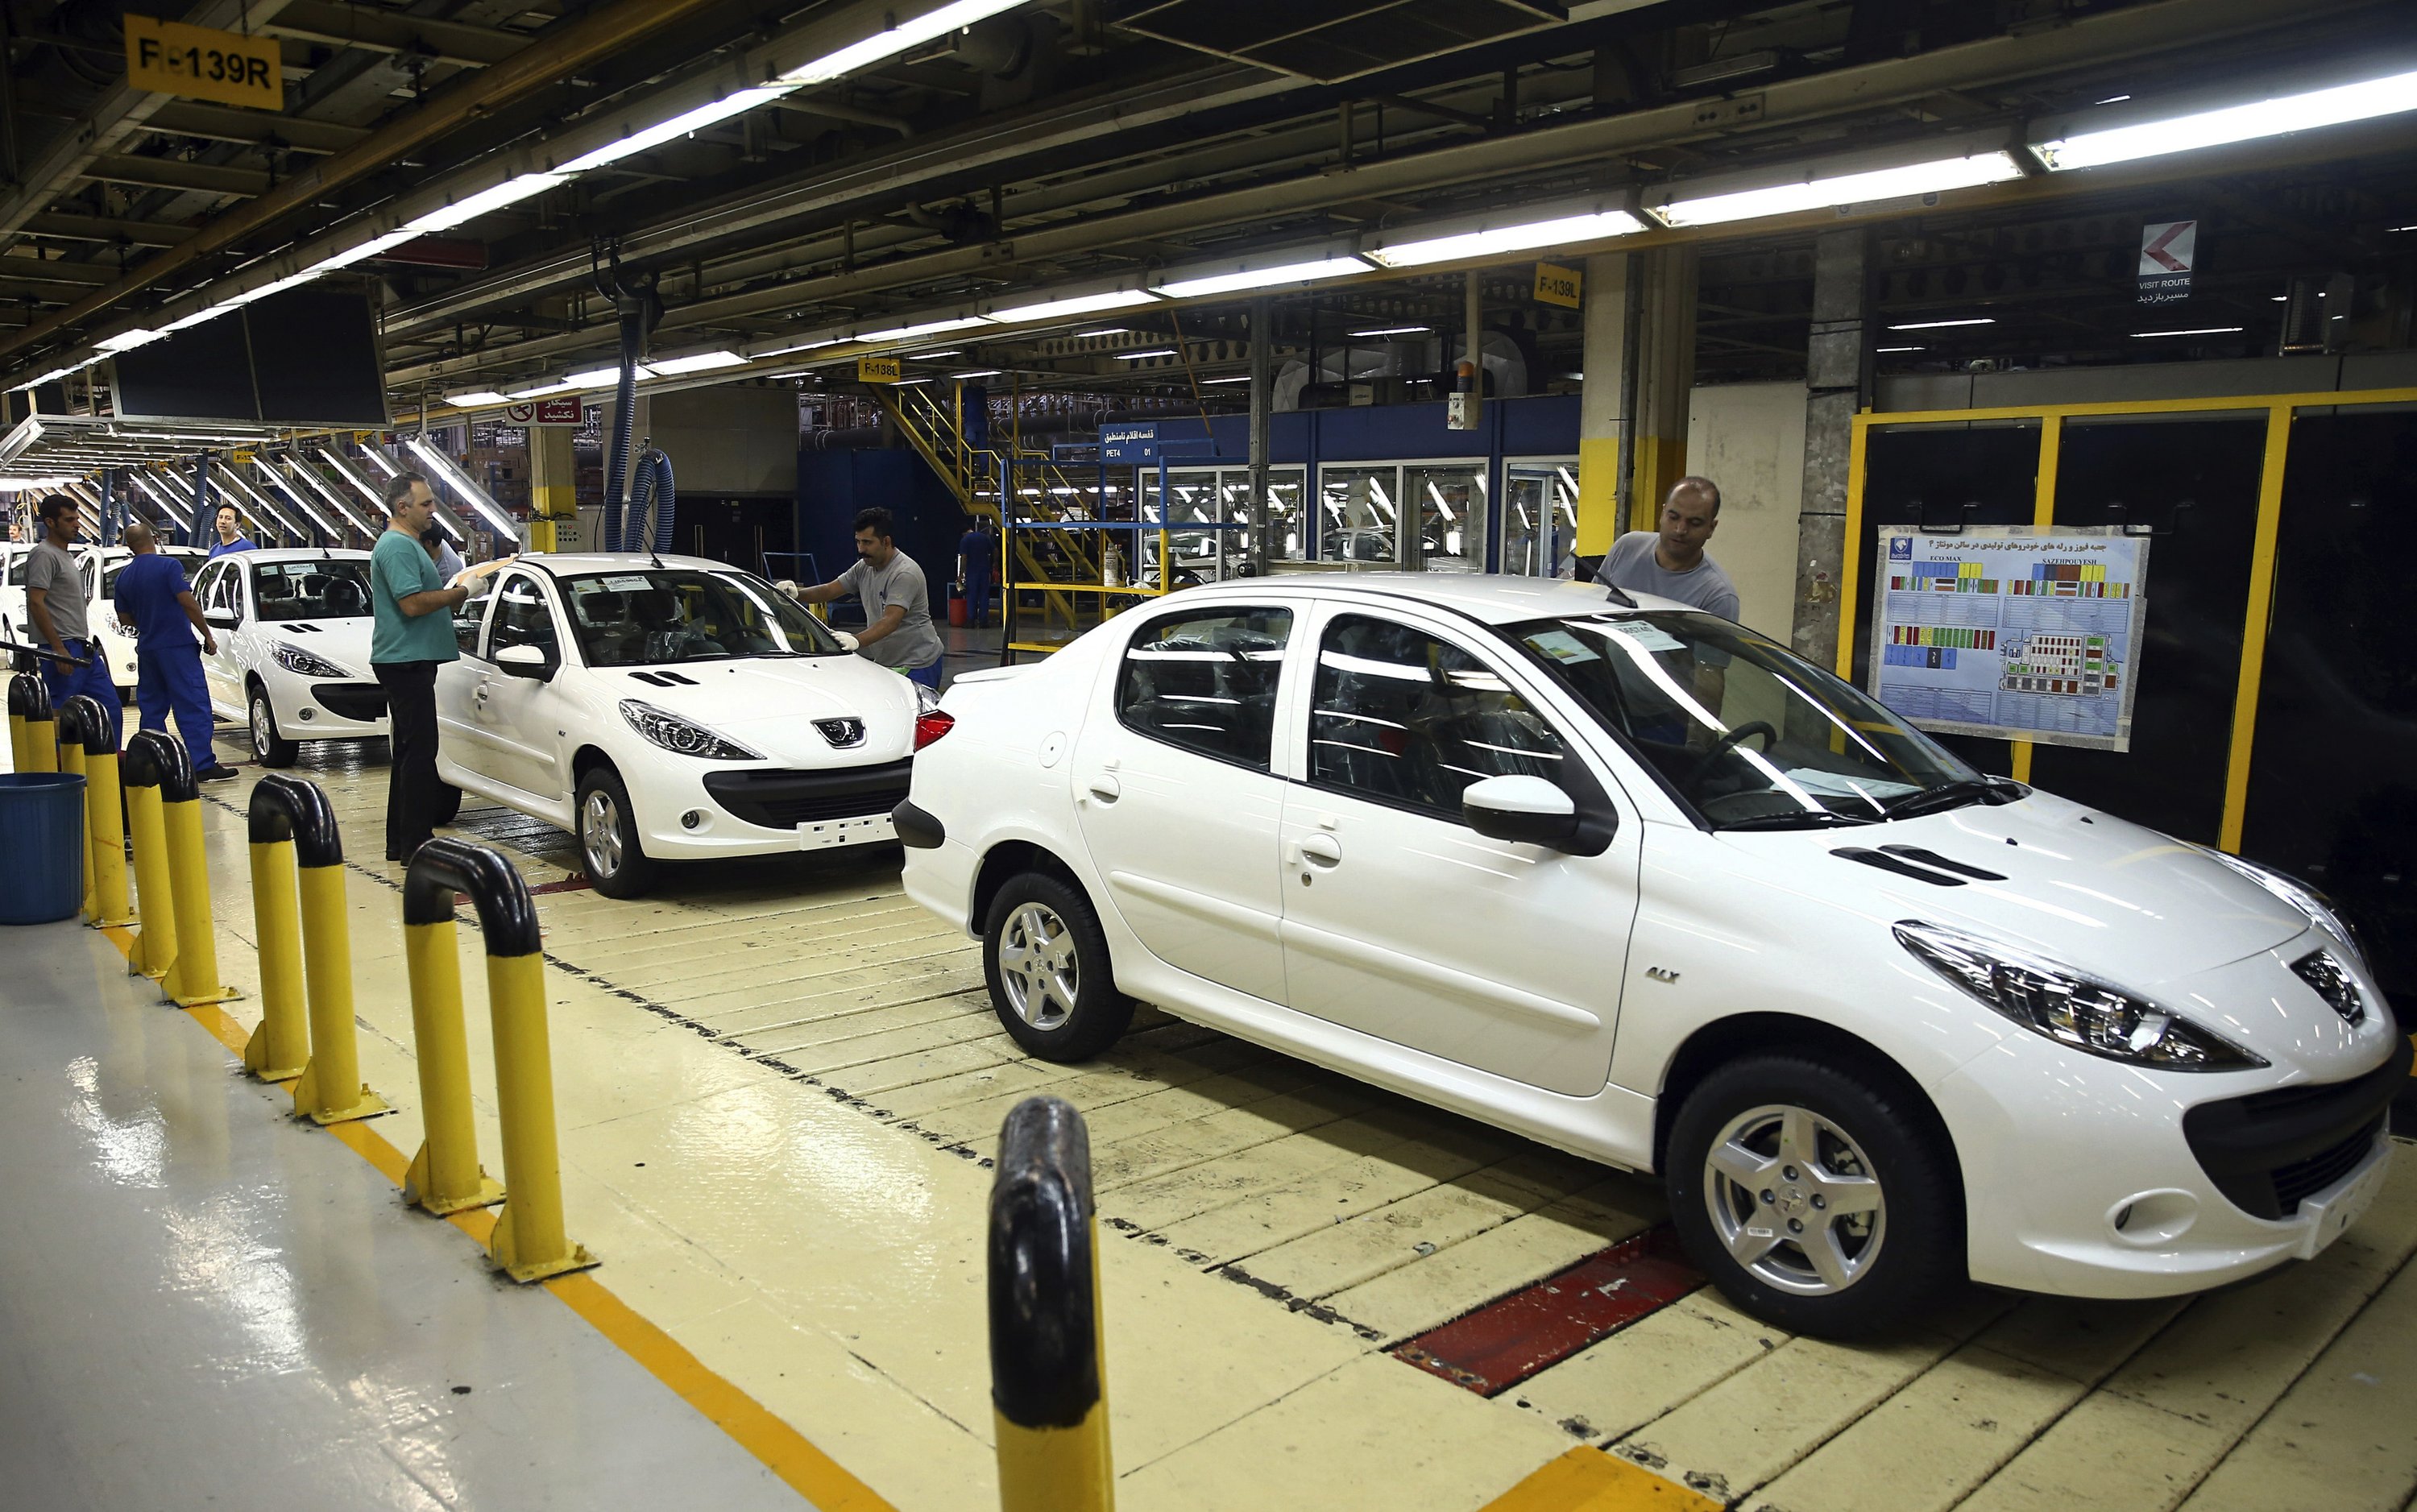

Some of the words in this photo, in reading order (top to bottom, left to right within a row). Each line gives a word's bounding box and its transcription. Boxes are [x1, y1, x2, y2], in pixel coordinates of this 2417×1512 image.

[139, 37, 271, 89] F-139R
[1540, 276, 1577, 298] F-139L
[2139, 280, 2159, 289] VISIT
[2161, 277, 2191, 288] ROUTE
[2137, 292, 2164, 304] بازدید
[2163, 292, 2189, 301] مسیر
[864, 362, 898, 376] F-138L
[544, 410, 574, 421] نکشید
[1138, 429, 1154, 439] قفسه
[1105, 449, 1121, 458] PET4
[1144, 448, 1151, 456] 01
